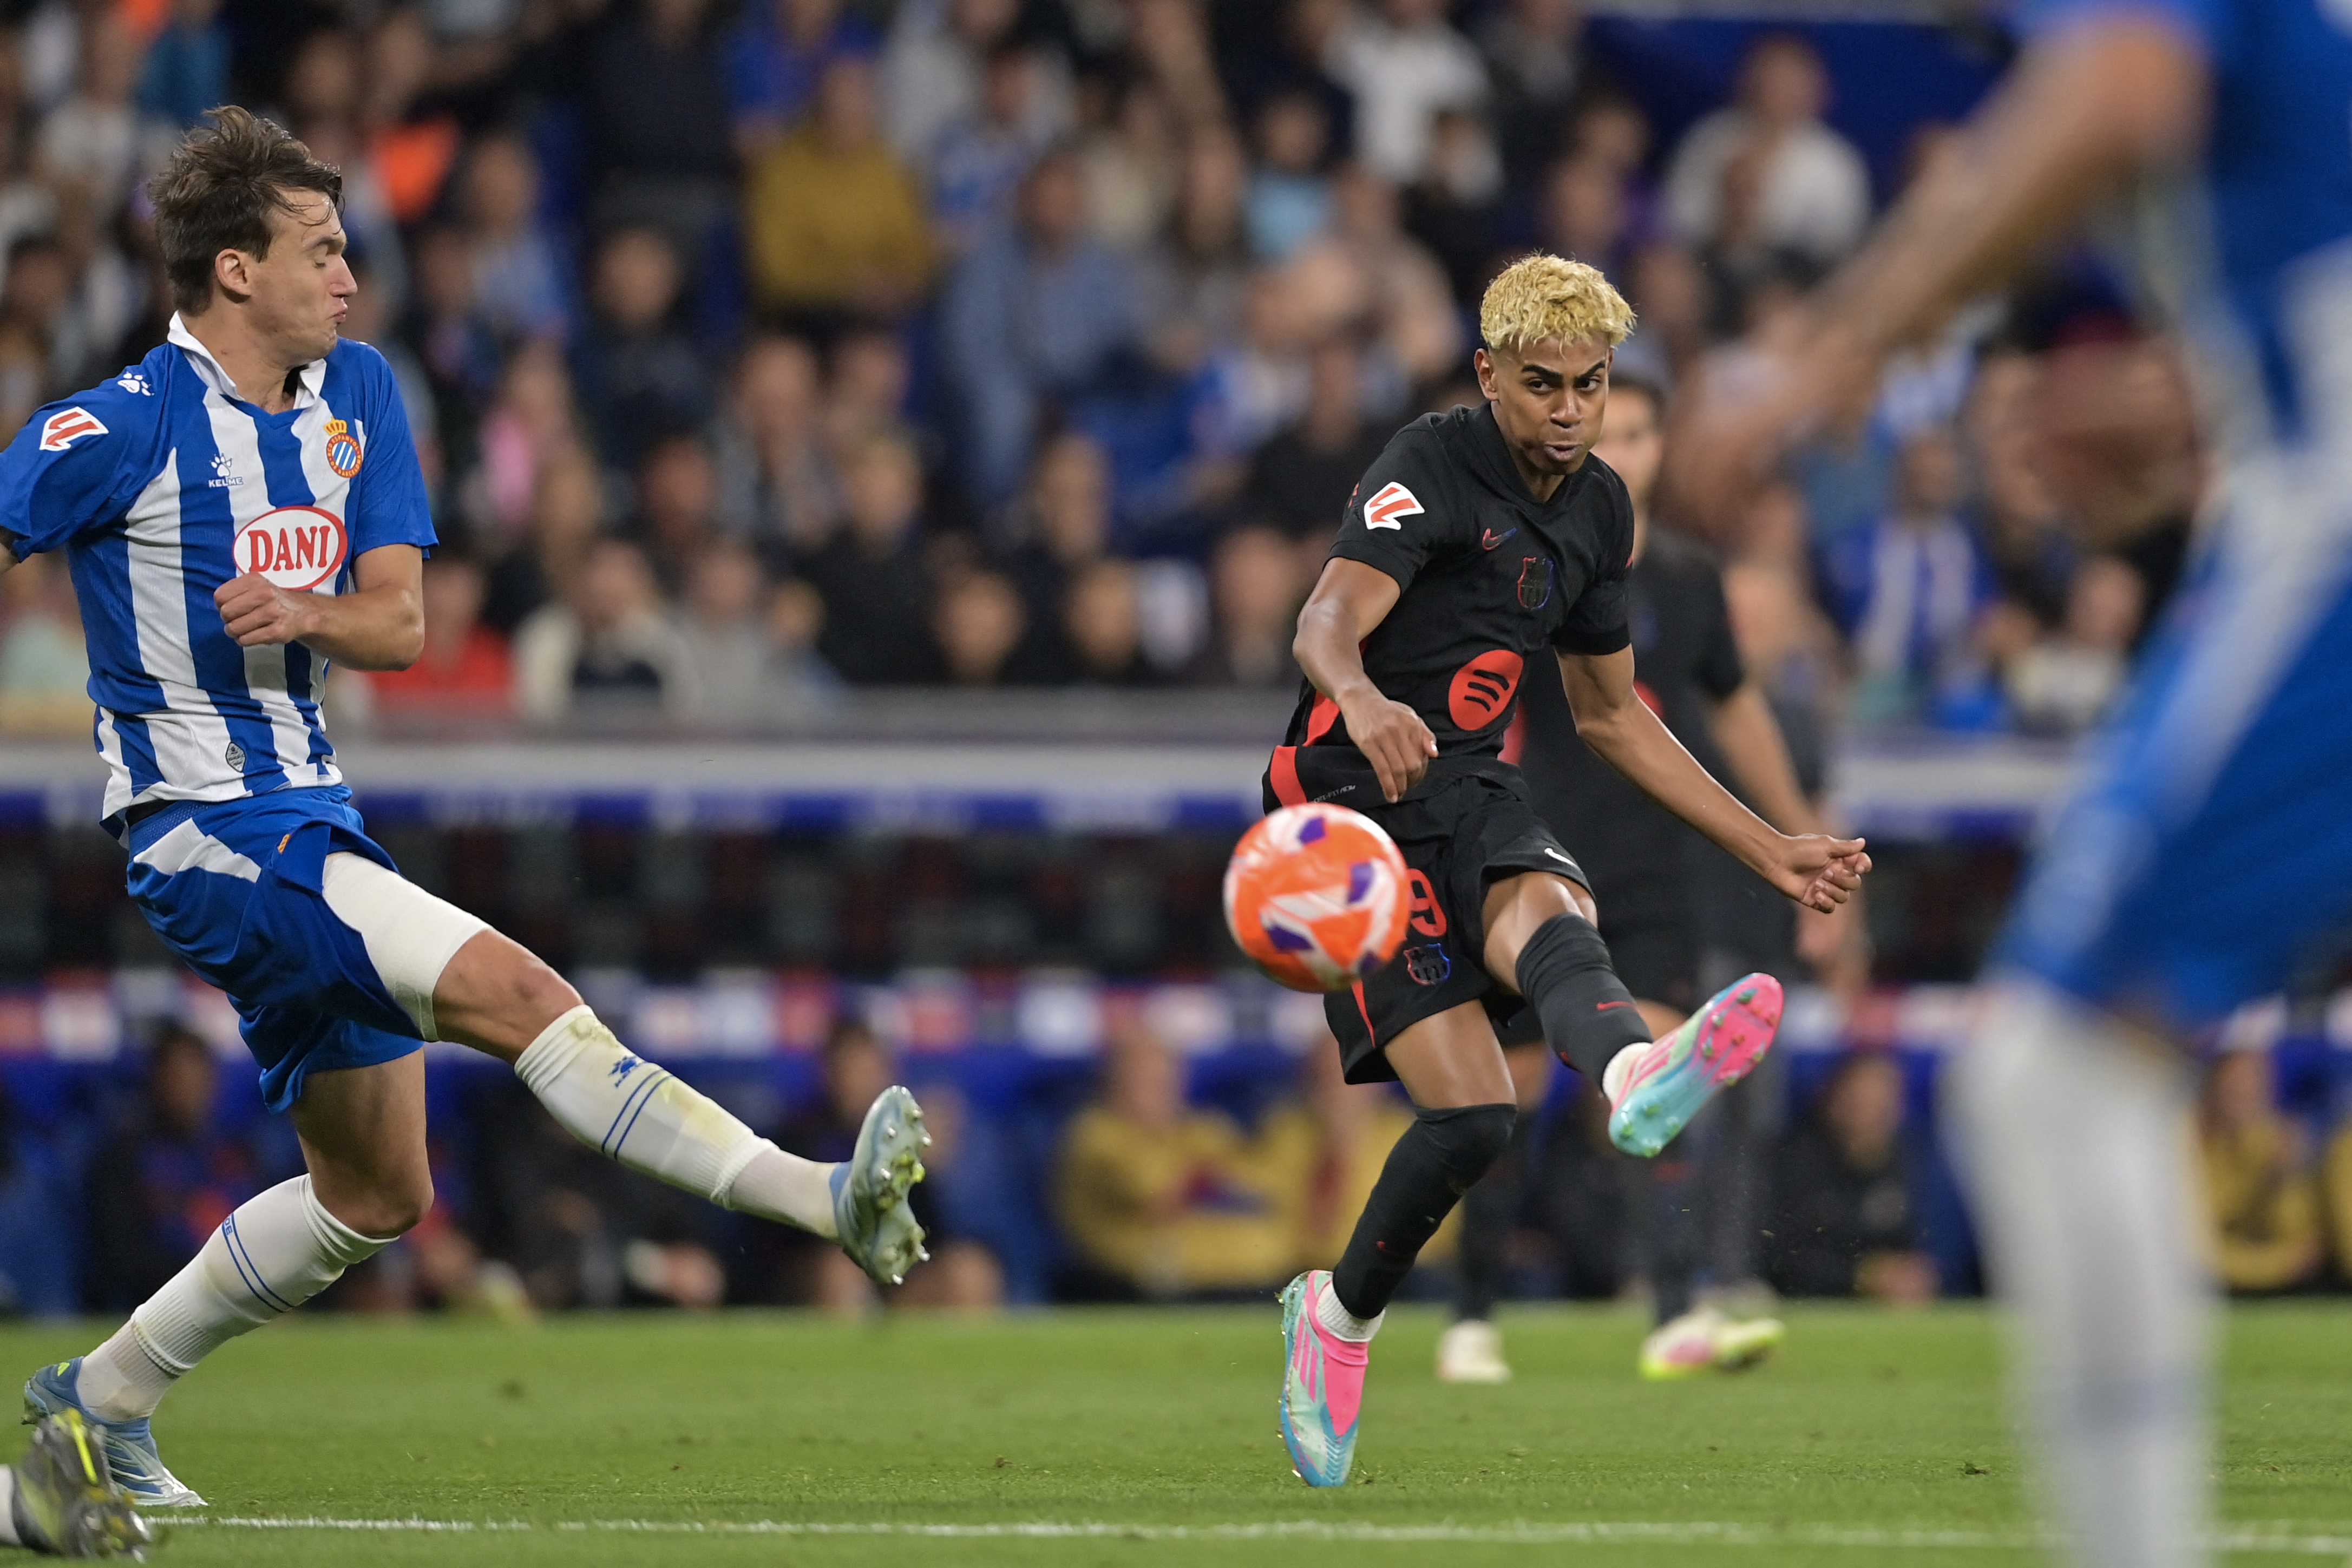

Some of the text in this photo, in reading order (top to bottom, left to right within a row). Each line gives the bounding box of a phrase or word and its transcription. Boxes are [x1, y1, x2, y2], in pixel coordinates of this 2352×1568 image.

[331, 435, 359, 450] ESPANYOL
[208, 477, 244, 488] KELME
[247, 525, 331, 573] DANI
[1404, 868, 1447, 941] 9
